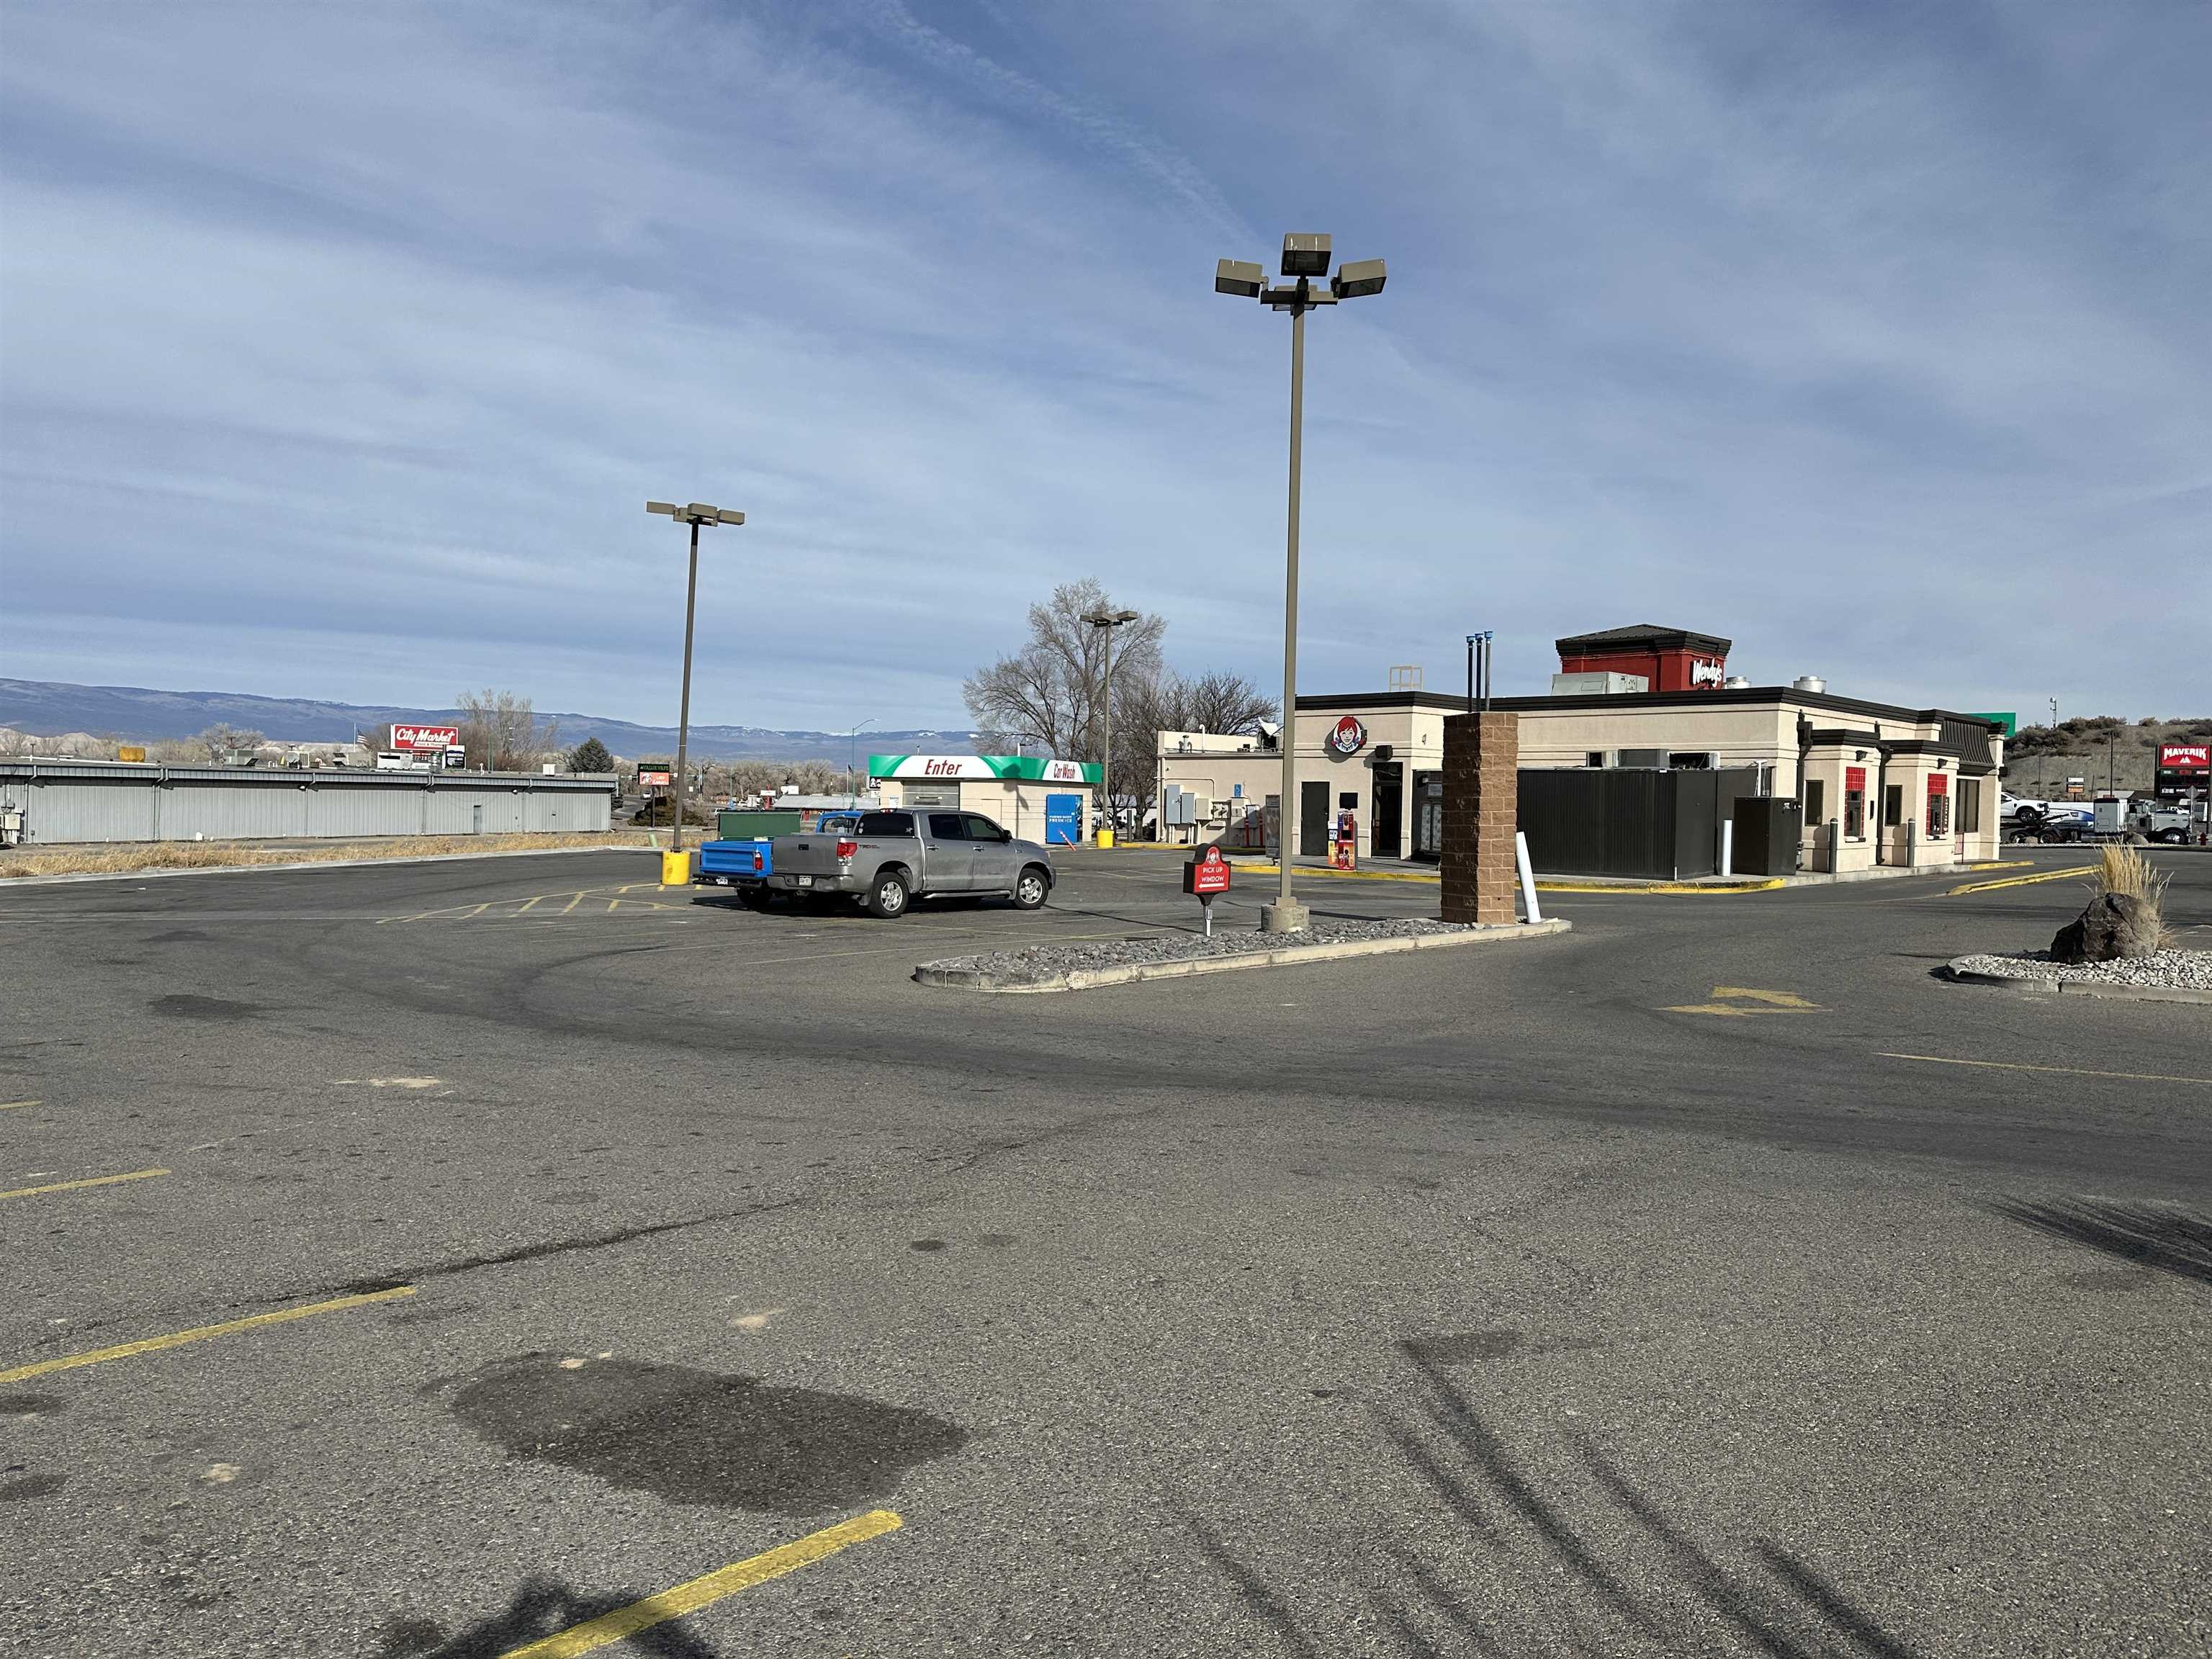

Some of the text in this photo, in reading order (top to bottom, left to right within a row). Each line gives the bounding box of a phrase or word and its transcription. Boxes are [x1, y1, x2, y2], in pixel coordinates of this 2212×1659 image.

[1693, 657, 1722, 688] Wendy's
[396, 728, 455, 744] City Market
[2163, 747, 2207, 760] MAVERIK
[925, 759, 962, 775] Enter
[1053, 763, 1076, 779] Car Wash
